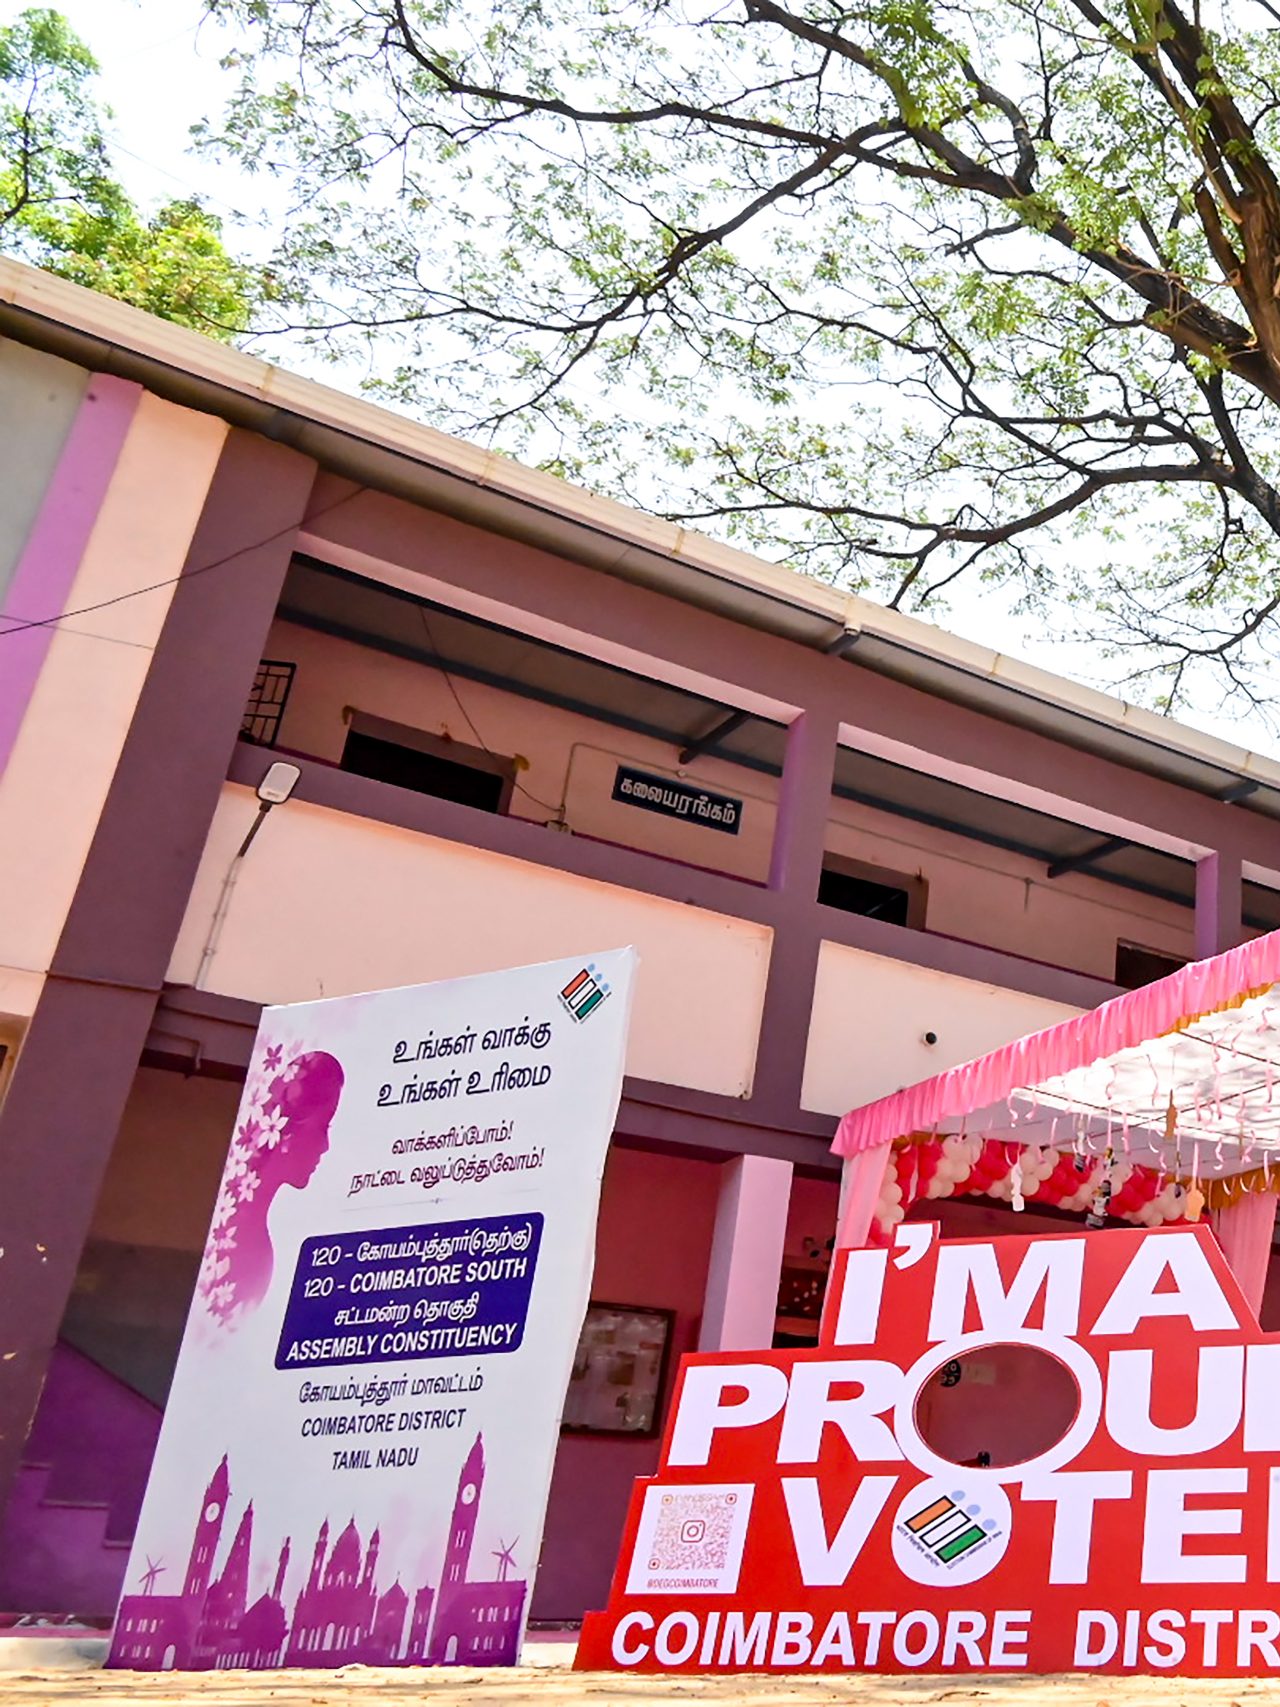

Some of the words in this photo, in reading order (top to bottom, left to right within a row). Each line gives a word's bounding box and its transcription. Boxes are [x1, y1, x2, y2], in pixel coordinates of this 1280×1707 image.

[620, 778, 735, 824] கலையரங்கம்
[392, 1025, 477, 1064] உங்கள்
[482, 1016, 551, 1050] வாக்கு
[377, 1069, 461, 1107] உங்கள்
[466, 1062, 551, 1096] உரிமை
[391, 1120, 514, 1155] வாக்களிப்போம்!
[347, 1167, 405, 1197] நாட்டை
[312, 1246, 341, 1266] 120
[304, 1276, 333, 1298] 120
[350, 1264, 462, 1293] COIMBATORE
[465, 1257, 528, 1283] SOUTH
[834, 1223, 1086, 1345] I'M
[1089, 1232, 1240, 1335] A
[334, 1301, 410, 1328] சட்டமன்ற
[414, 1291, 479, 1326] தொகுதி
[286, 1334, 378, 1362] ASSEMBLY
[381, 1323, 518, 1353] CONSTITUENCY
[299, 1373, 408, 1407] கோயம்புத்தூர்
[411, 1367, 484, 1396] மாவட்டம்
[301, 1413, 395, 1437] COIMBATORE
[398, 1408, 466, 1431] DISTRICT
[332, 1450, 372, 1470] TAMIL
[376, 1447, 419, 1468] NADU
[611, 1609, 1032, 1668] COIMBATORE
